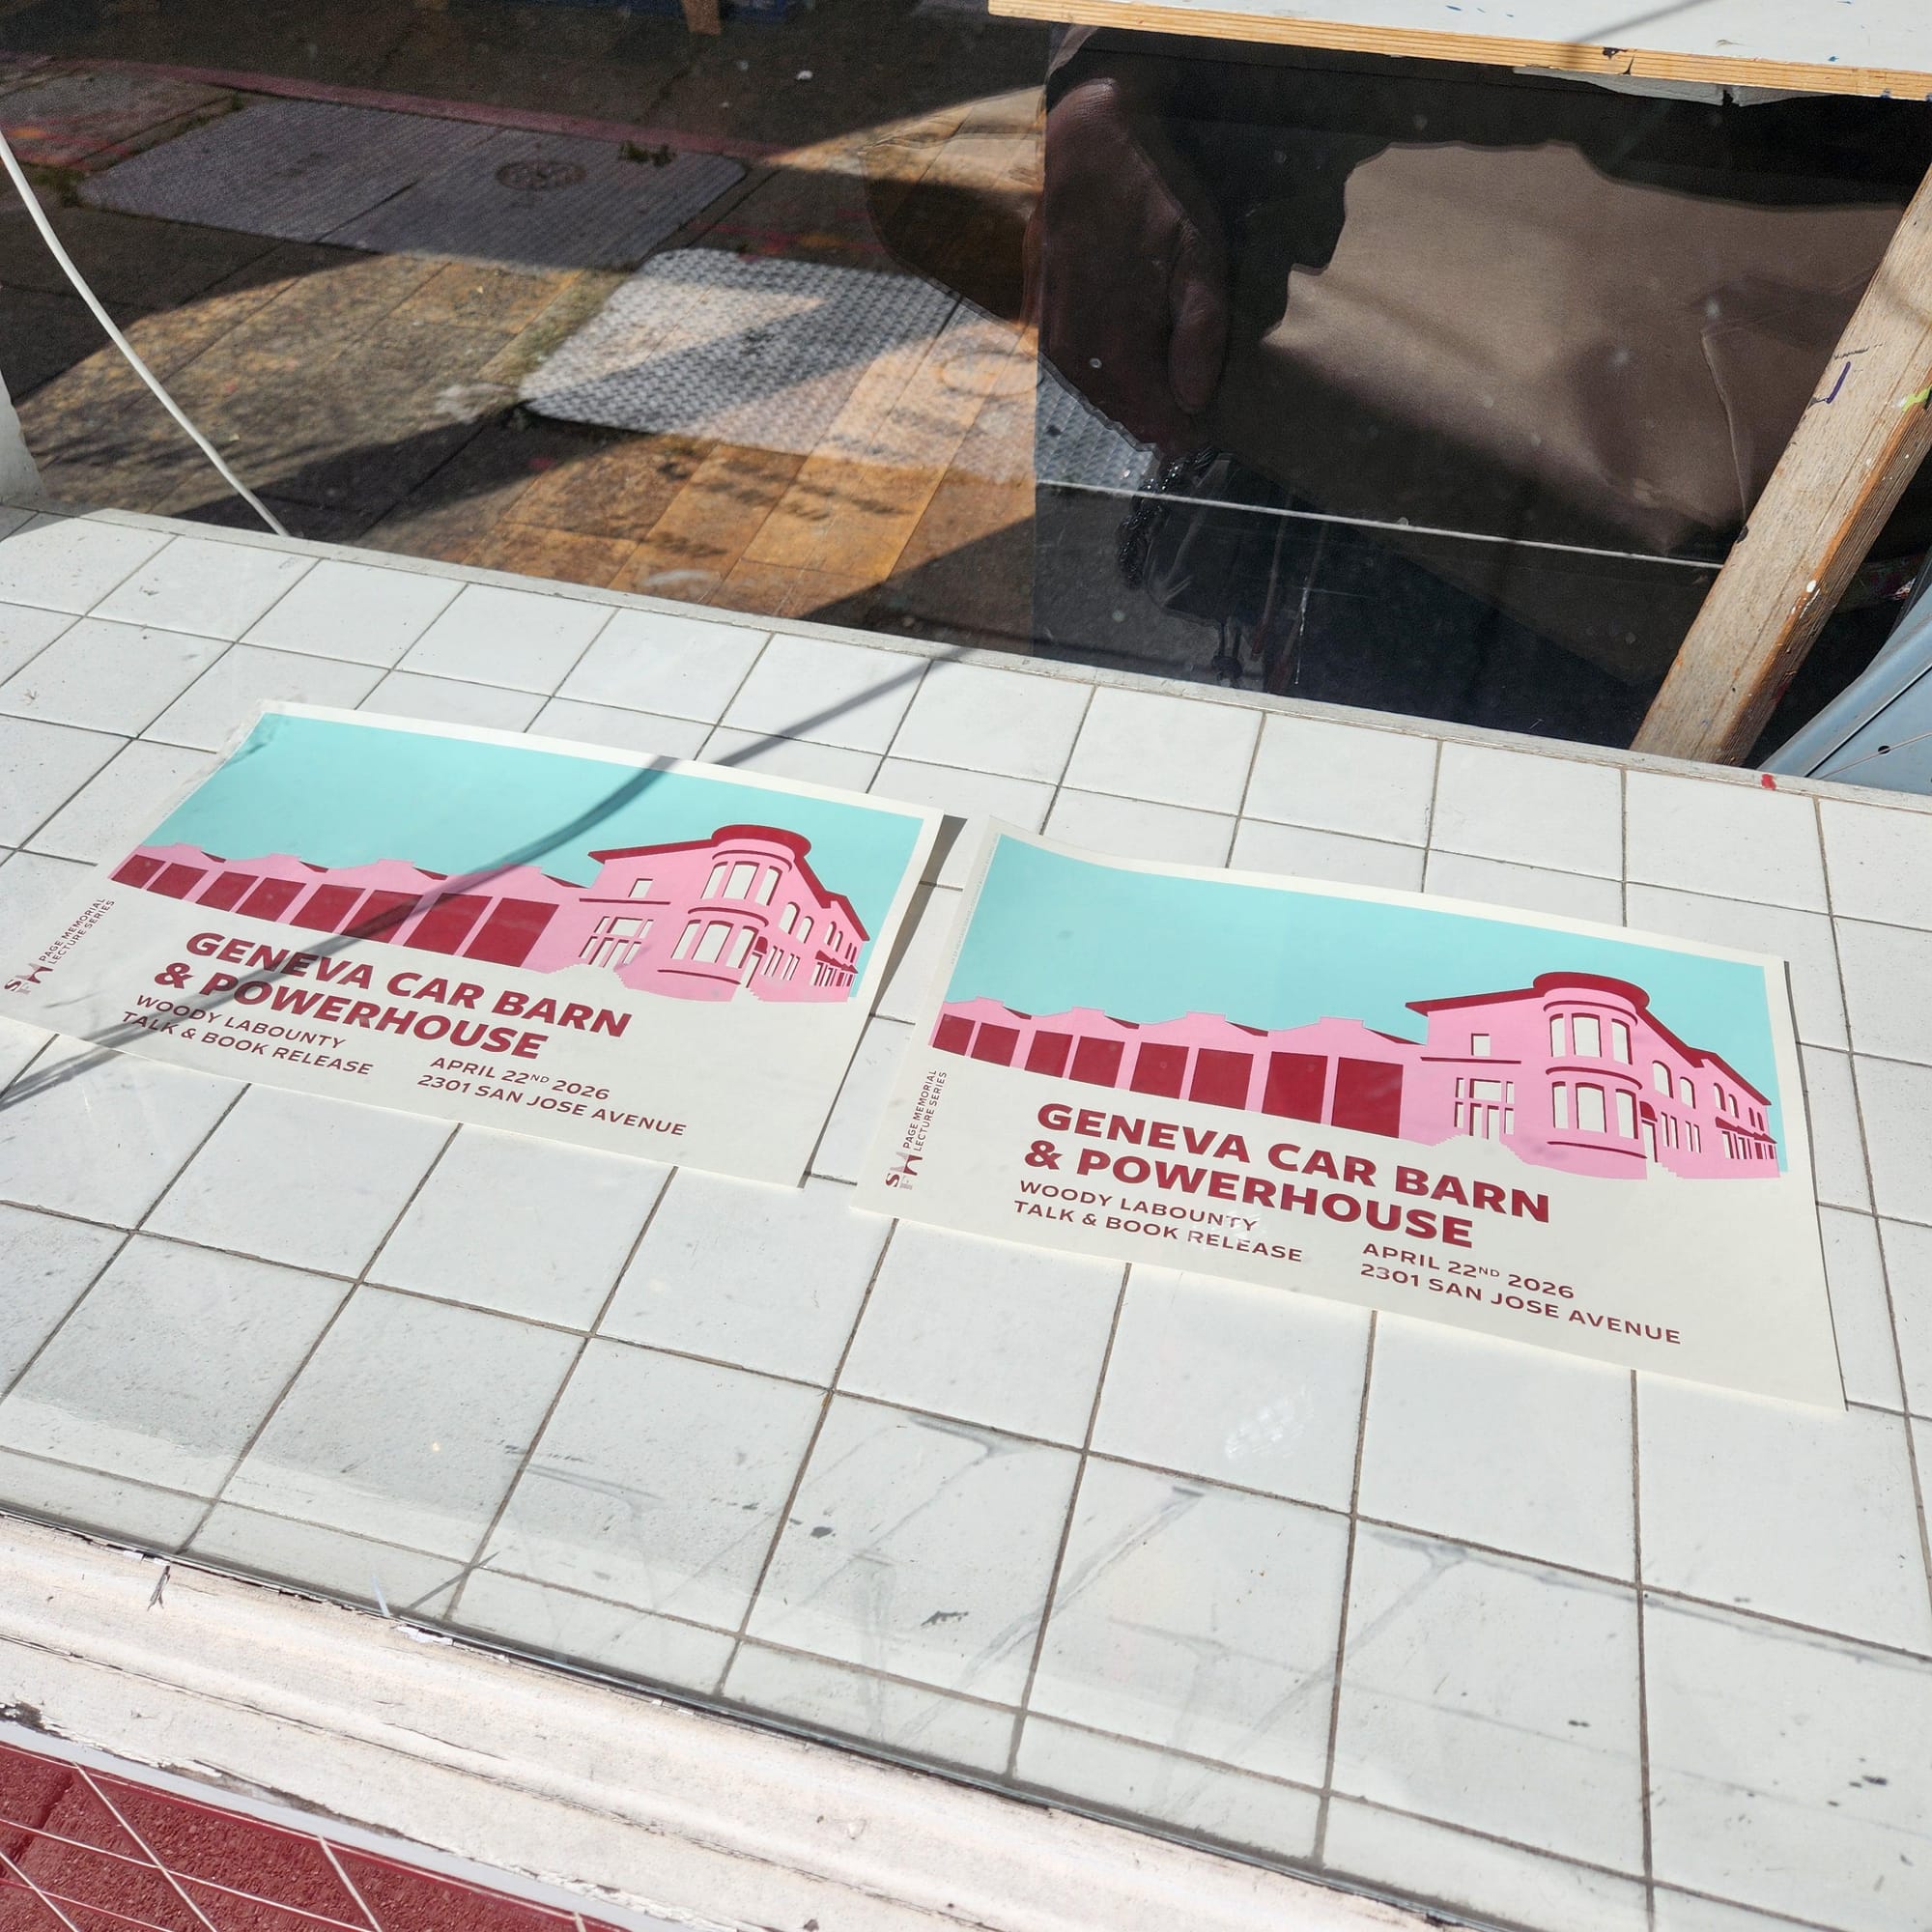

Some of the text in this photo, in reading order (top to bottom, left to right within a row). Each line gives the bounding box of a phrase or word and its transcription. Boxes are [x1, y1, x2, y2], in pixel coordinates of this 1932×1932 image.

[39, 899, 105, 962] PAGE MEMORIAL
[48, 900, 115, 964] LECTURE SERIES
[155, 962, 549, 1059] & POWERHOUSE
[185, 932, 632, 1037] GENEVA CAR BARN
[123, 1011, 374, 1075] TALK & BOOK RELEASE
[136, 994, 346, 1049] WOODY LABOUNTY
[417, 1074, 687, 1136] 2301 SAN JOSE AVENUE
[430, 1057, 496, 1078] APRIL
[552, 1080, 611, 1100] 2026
[903, 1070, 937, 1149] PAGE MEMORIAL
[913, 1071, 947, 1151] LECTURE SERIES
[1024, 1139, 1473, 1248] & POWERHOUSE
[1037, 1103, 1549, 1223] GENEVA CAR BARN
[1014, 1200, 1303, 1263] TALK & BOOK RELEASE
[1020, 1180, 1259, 1232] WOODY LABOUNTY
[1362, 1242, 1440, 1270] APRIL
[1508, 1273, 1575, 1299] 2026
[1360, 1263, 1682, 1345] 2301 SAN JOSE AVENUE
